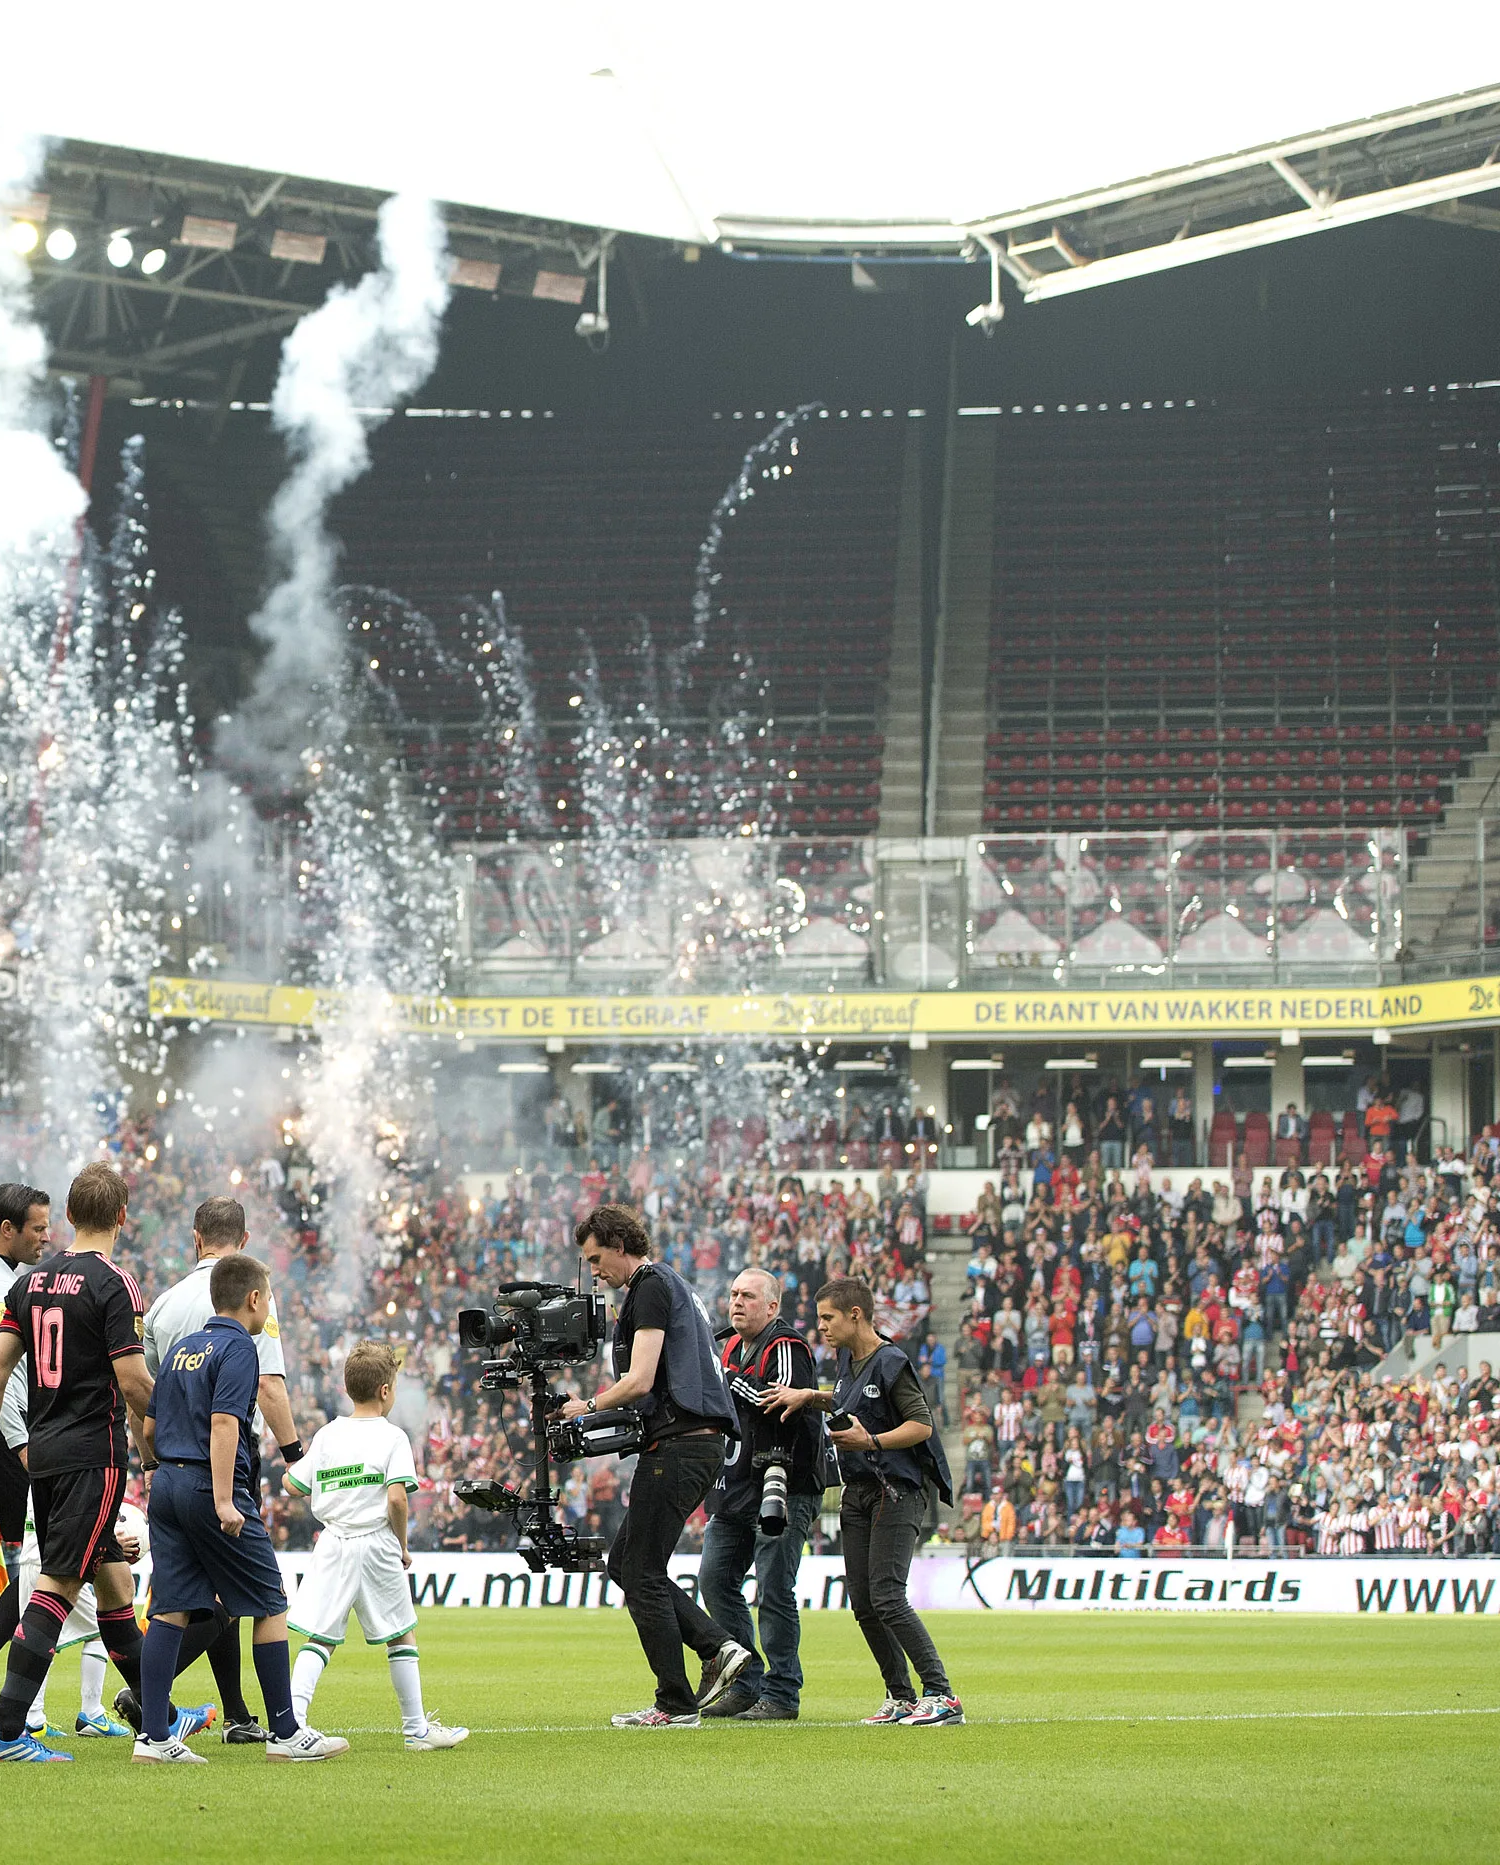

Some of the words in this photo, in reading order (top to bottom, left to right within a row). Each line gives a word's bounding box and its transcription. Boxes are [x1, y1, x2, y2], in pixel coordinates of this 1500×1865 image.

[975, 1001, 1008, 1023] DE
[1015, 1001, 1098, 1023] KRANT
[1107, 1000, 1159, 1022] VAN
[1166, 998, 1273, 1021] WAKKER
[1280, 994, 1423, 1020] NEDERLAND
[1468, 984, 1495, 1011] De
[444, 1006, 511, 1028] LEEST
[522, 1007, 554, 1027] DE
[566, 1005, 711, 1027] TELEGRAAF
[772, 1001, 802, 1026] De
[812, 998, 921, 1033] Telegraaf
[27, 1271, 49, 1294] DE
[47, 1273, 85, 1296] JONG
[31, 1305, 64, 1389] 10
[171, 1346, 206, 1371] freo
[321, 1467, 354, 1479] EREDIVISIE
[354, 1465, 362, 1473] IS
[339, 1480, 353, 1488] DAN
[1005, 1569, 1301, 1603] MultiCards
